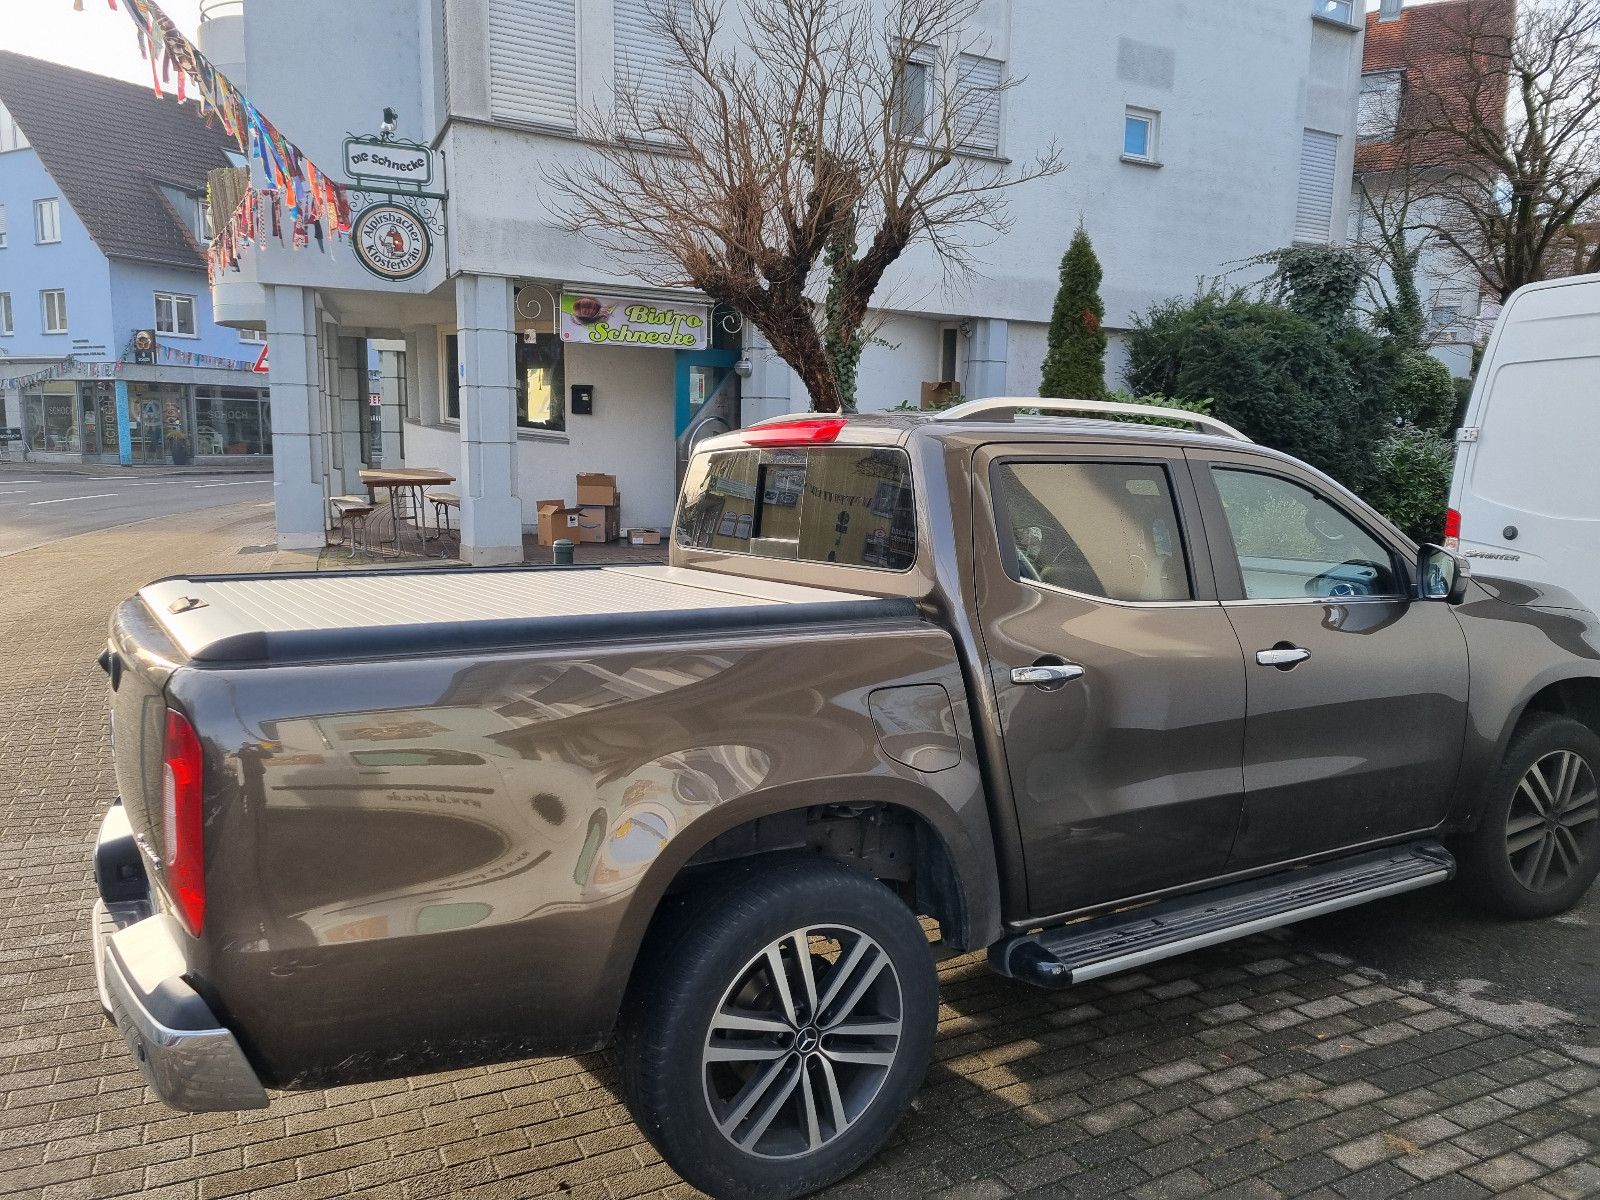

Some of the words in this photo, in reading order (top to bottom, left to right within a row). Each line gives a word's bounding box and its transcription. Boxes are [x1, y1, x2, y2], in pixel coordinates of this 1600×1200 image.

[371, 154, 425, 172] Schnecke
[363, 213, 420, 243] Alpirsbacher
[366, 244, 421, 270] Klosterbräu
[624, 304, 703, 328] Bistro
[589, 321, 696, 346] Schnecke
[1464, 550, 1521, 562] SPRINTER
